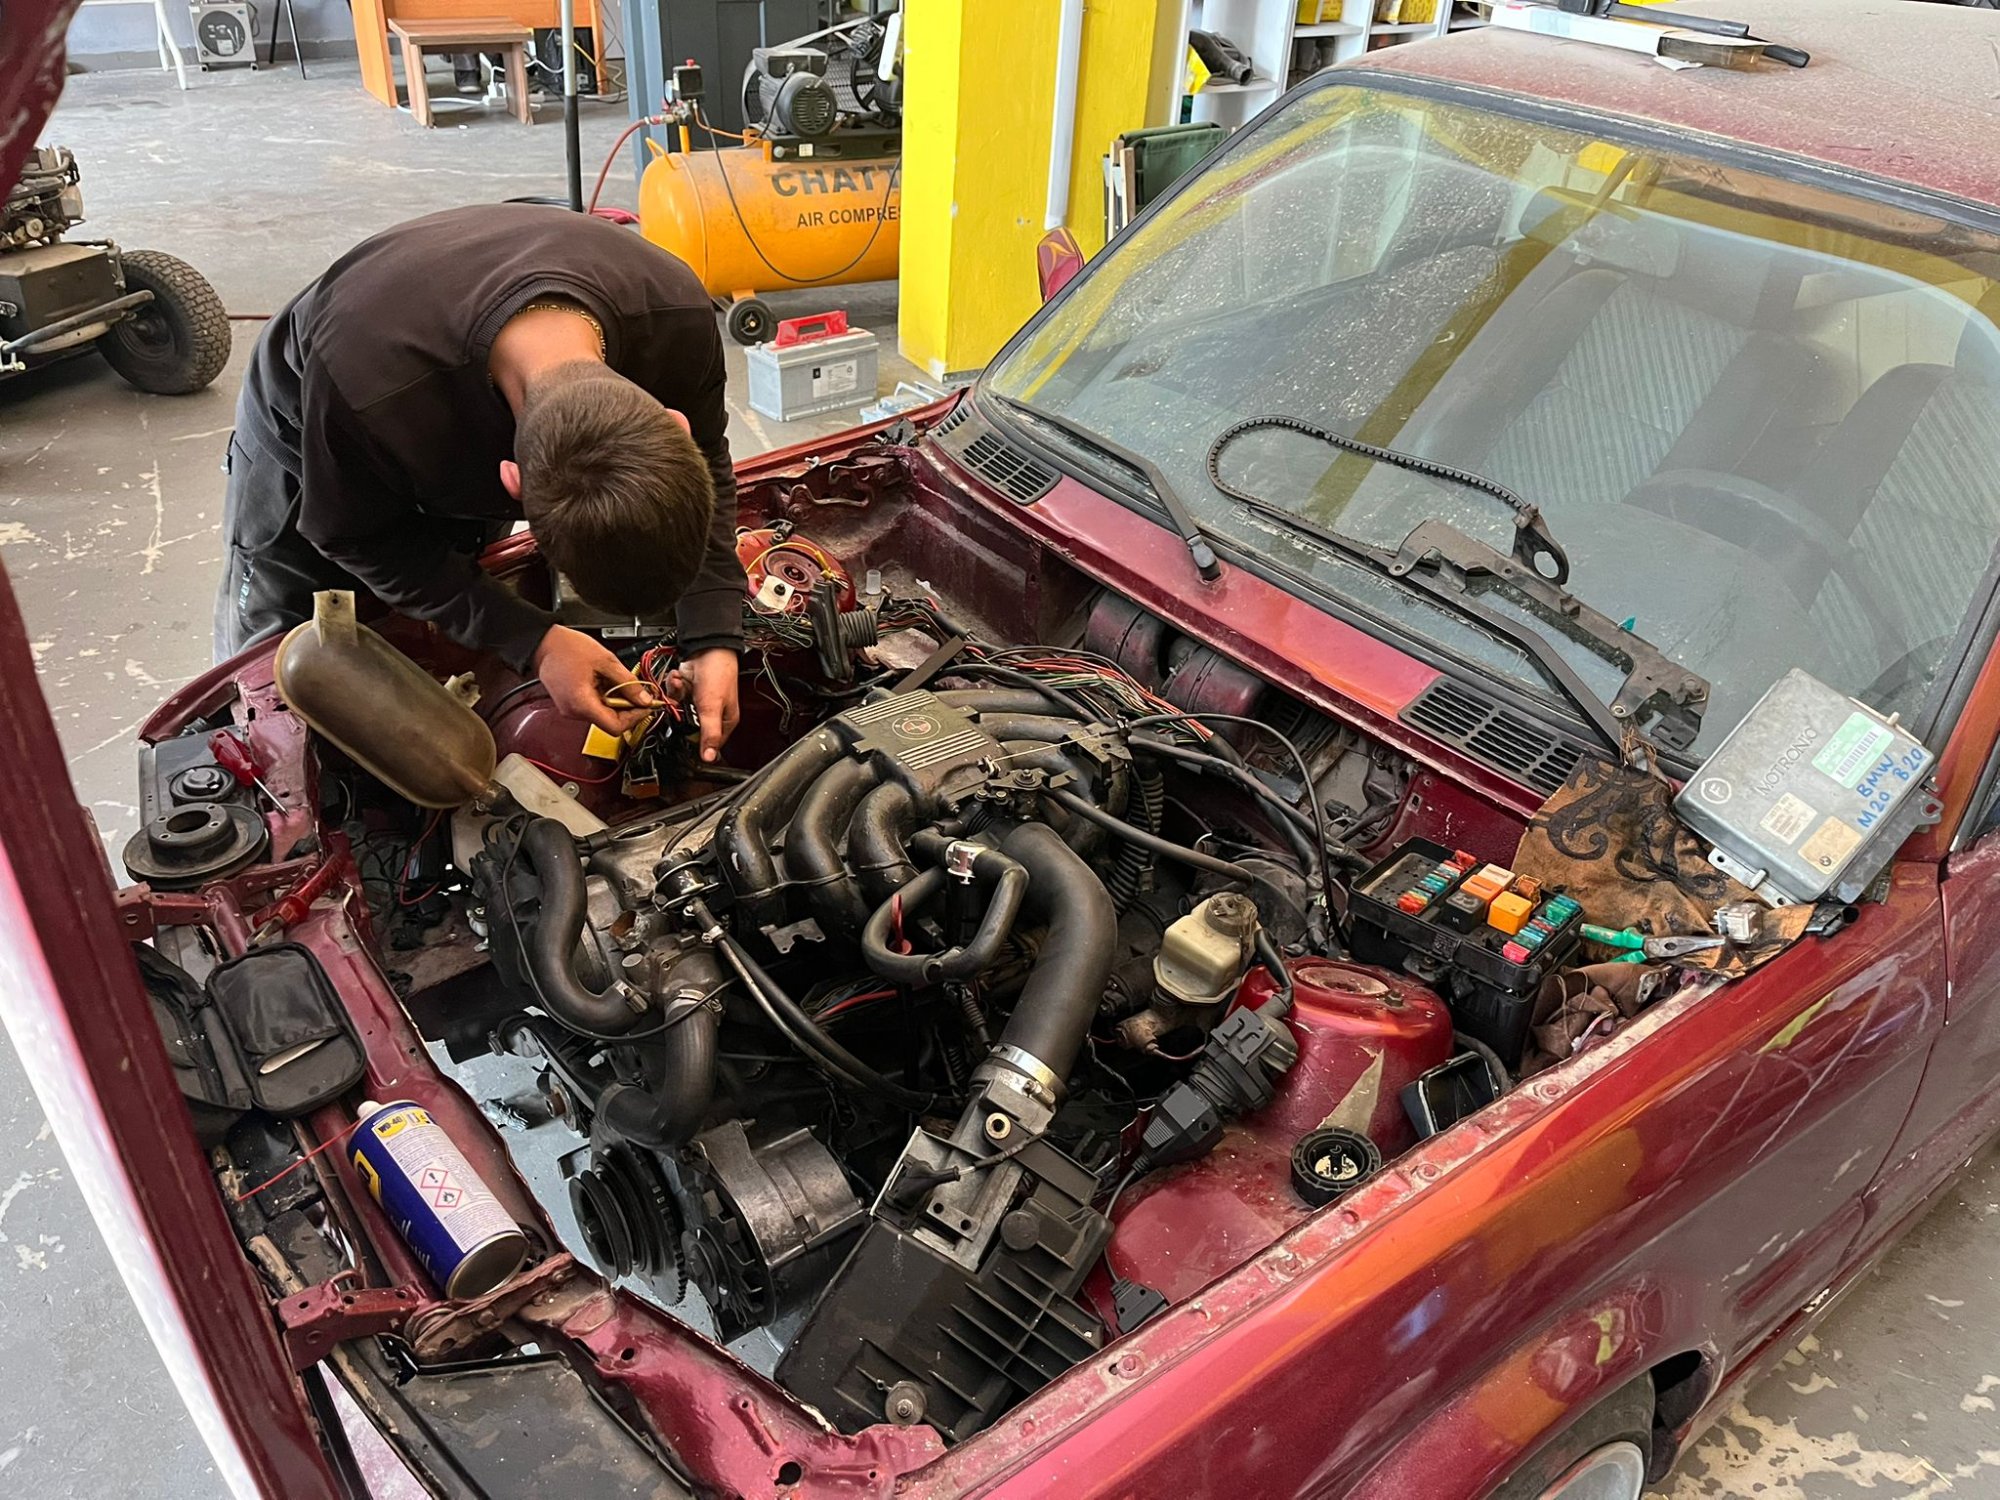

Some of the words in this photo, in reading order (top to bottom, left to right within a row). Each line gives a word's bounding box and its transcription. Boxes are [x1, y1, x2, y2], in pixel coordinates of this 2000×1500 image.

[797, 211, 825, 228] AIR
[829, 205, 901, 224] COMPRE
[1757, 727, 1818, 796] MOTRONIC
[1856, 753, 1894, 798] BMW
[378, 1115, 403, 1134] WD-40
